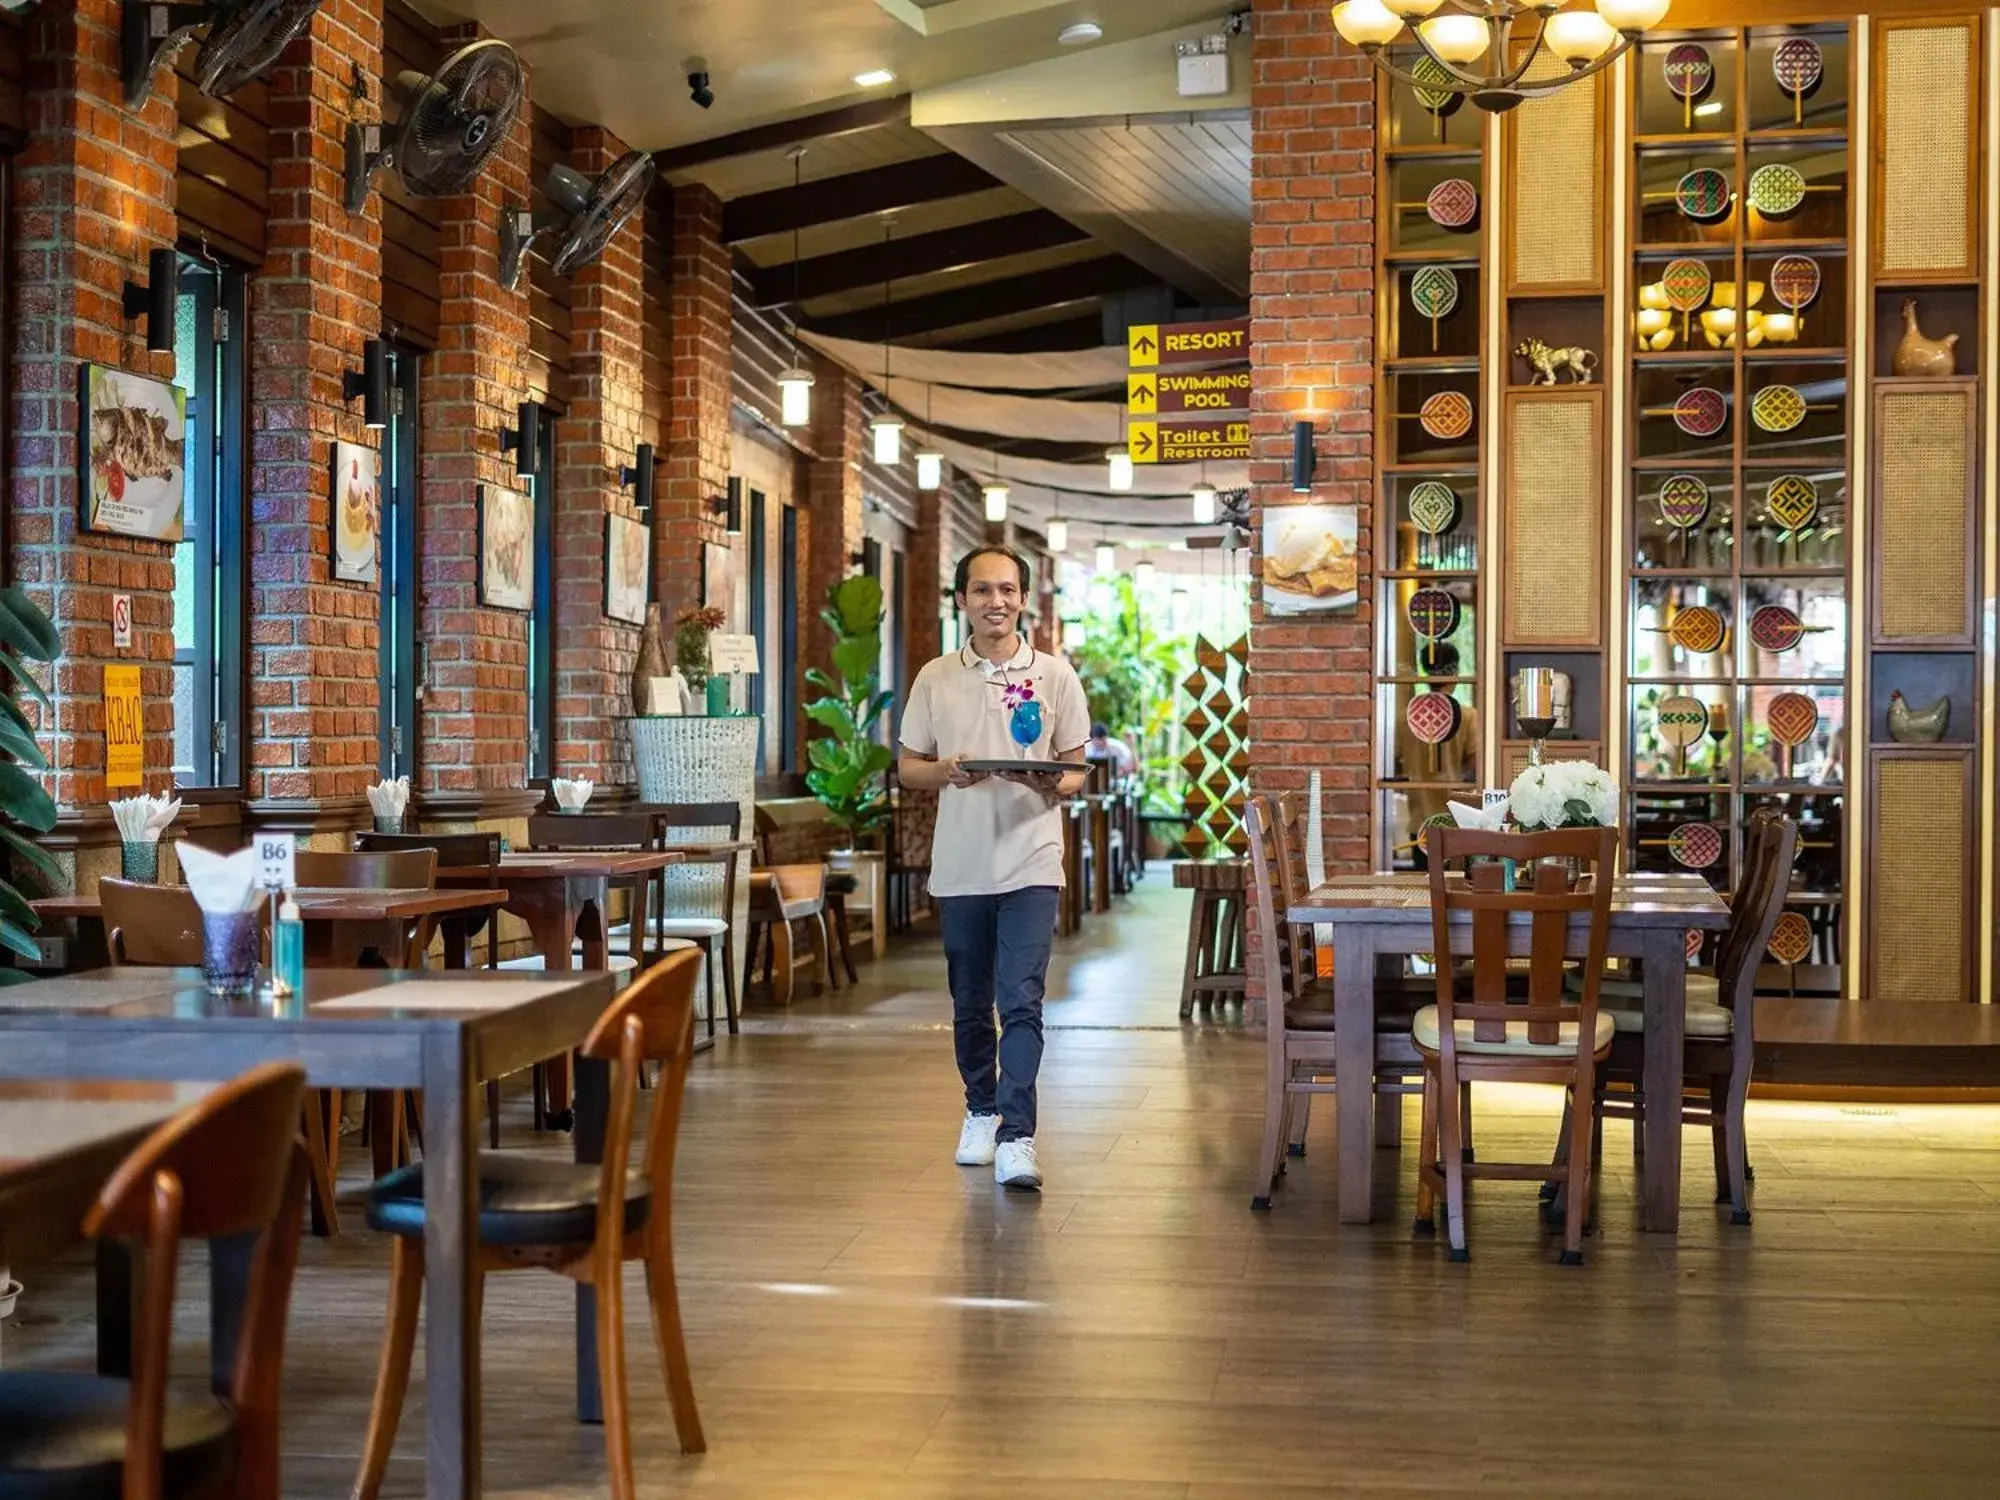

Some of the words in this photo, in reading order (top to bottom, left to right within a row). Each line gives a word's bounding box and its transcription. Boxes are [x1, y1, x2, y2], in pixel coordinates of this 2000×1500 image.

[1166, 331, 1244, 351] RESORT
[1159, 374, 1250, 391] SWIMMING
[1184, 394, 1231, 407] POOL
[1160, 428, 1221, 443] Toilet
[1164, 447, 1250, 459] Restroom
[263, 842, 287, 860] B6
